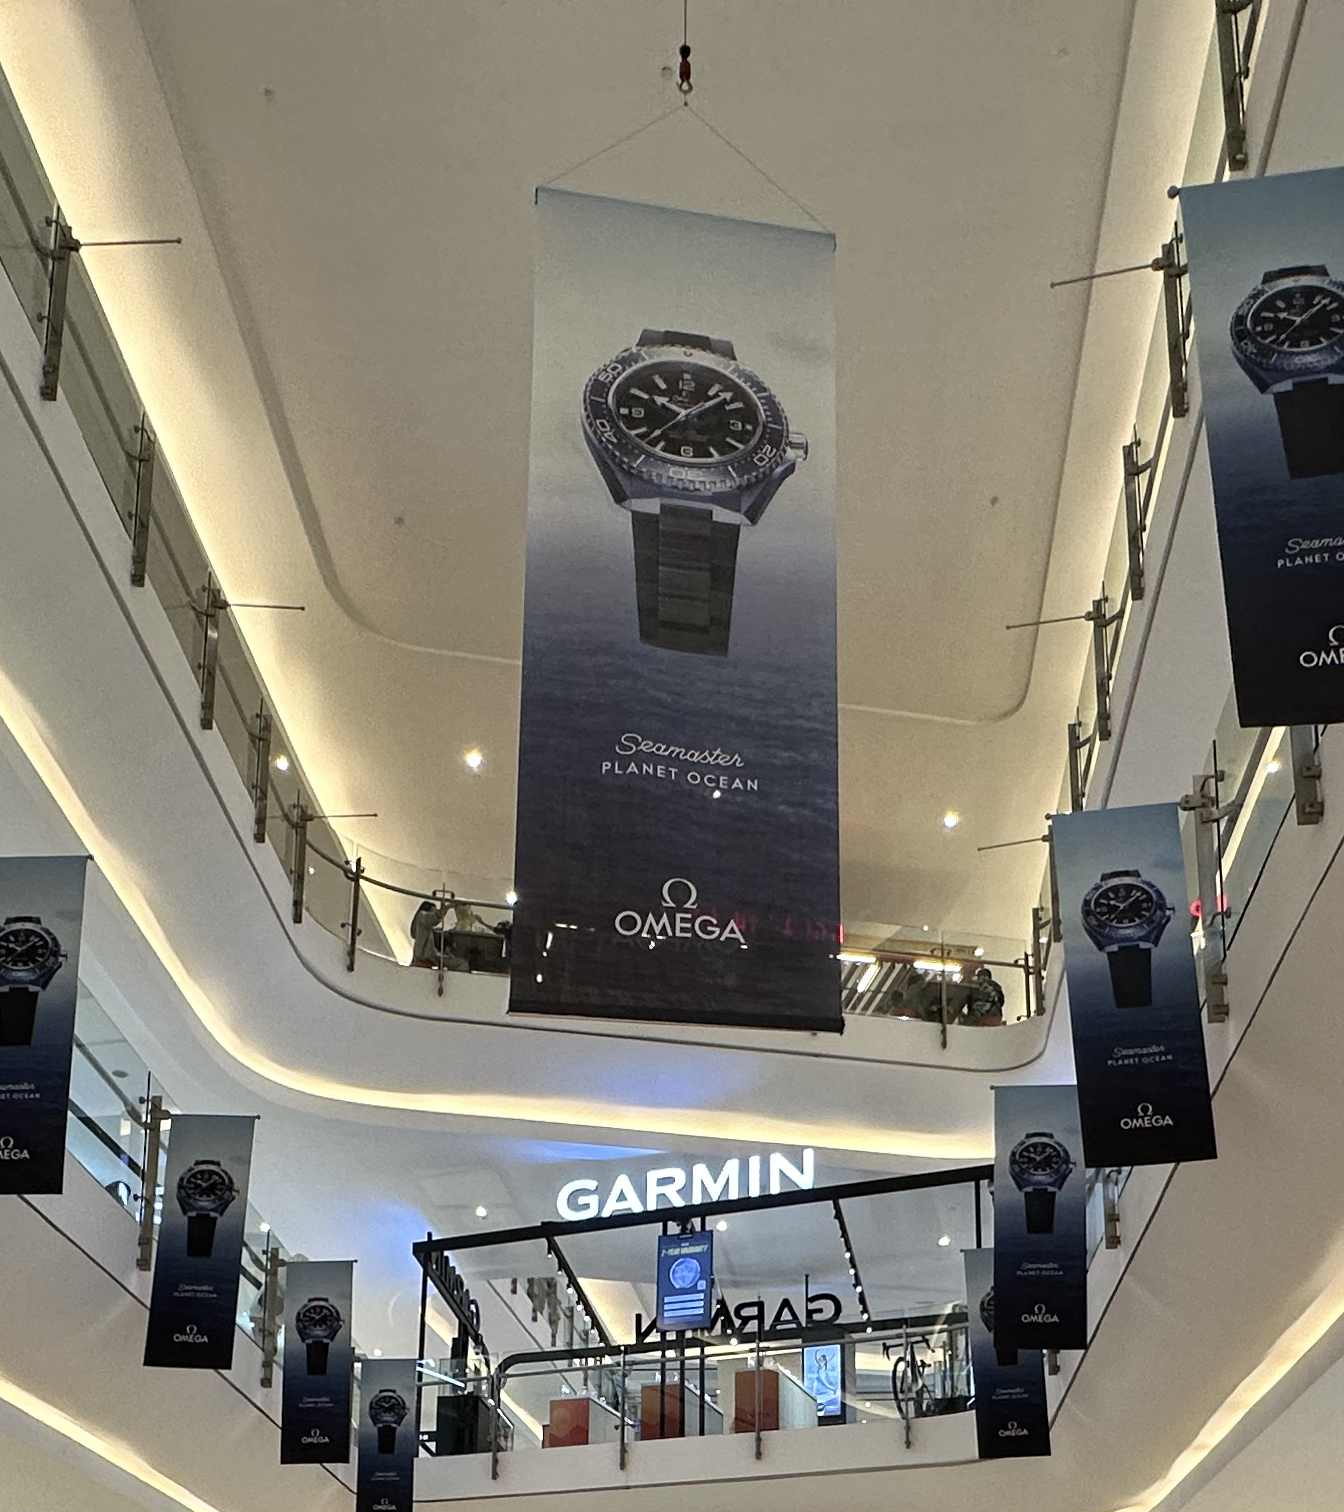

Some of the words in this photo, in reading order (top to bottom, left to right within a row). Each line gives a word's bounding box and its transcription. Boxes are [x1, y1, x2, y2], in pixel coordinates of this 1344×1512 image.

[1277, 552, 1329, 568] PLANET
[615, 732, 745, 768] Seamaster
[601, 761, 679, 780] PLANET
[687, 771, 759, 792] OCEAN
[614, 910, 747, 944] OMEGA
[1120, 1114, 1174, 1130] OMEGA
[556, 1147, 815, 1222] GARMIN
